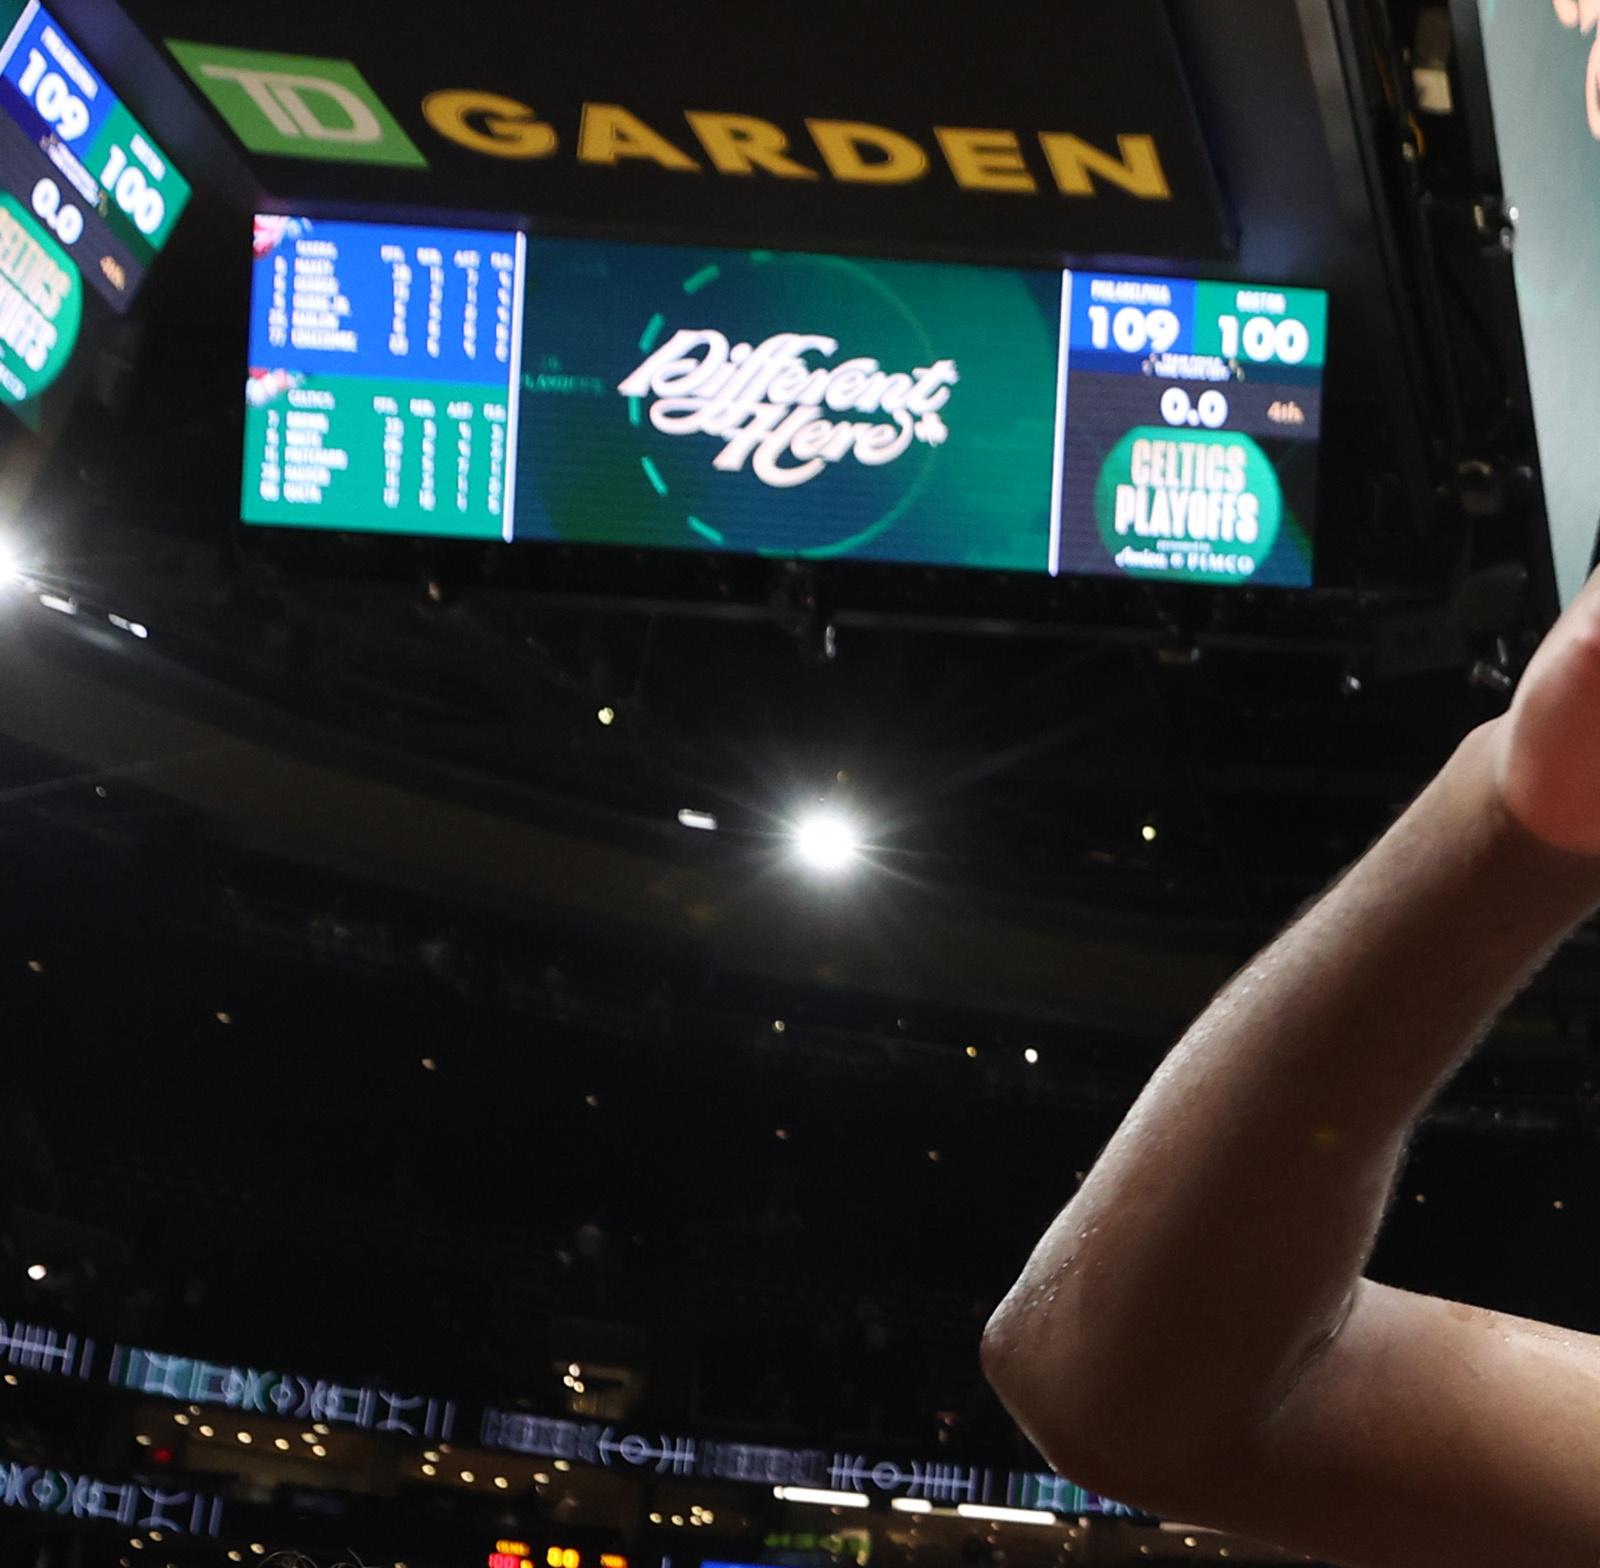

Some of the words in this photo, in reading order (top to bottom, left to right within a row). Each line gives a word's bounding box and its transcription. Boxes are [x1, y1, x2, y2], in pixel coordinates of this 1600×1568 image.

[19, 48, 90, 141] 109
[202, 64, 382, 144] TD
[420, 88, 1171, 200] GARDEN
[32, 178, 83, 244] 0.0
[100, 144, 164, 233] 100
[1088, 305, 1180, 353] 109
[1218, 315, 1309, 364] 100
[617, 329, 958, 414] Different
[1160, 387, 1228, 428] 0.0
[1131, 438, 1247, 492] CELTICS
[1114, 484, 1259, 544] PLAYOFFS
